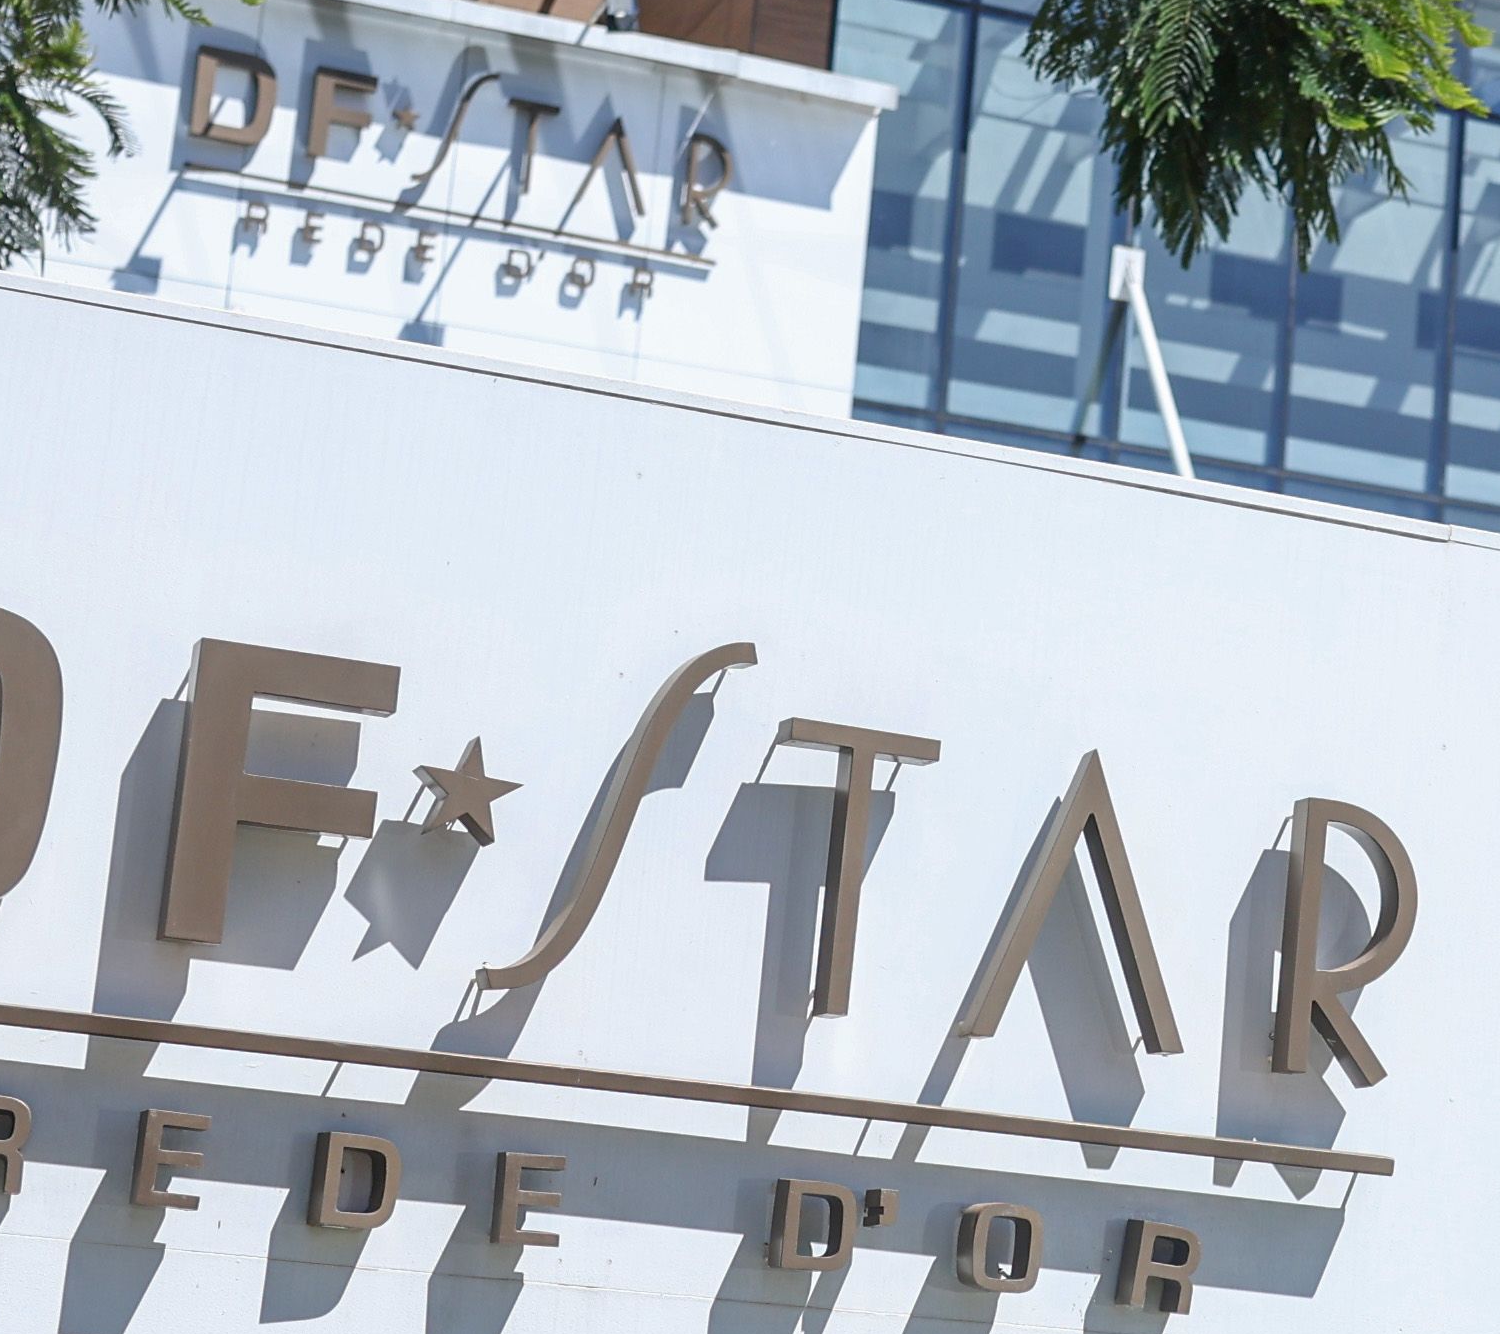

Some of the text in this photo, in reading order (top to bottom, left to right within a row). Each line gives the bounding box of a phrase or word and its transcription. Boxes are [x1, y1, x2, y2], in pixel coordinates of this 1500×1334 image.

[243, 202, 654, 300] REDE D'OR
[767, 1177, 1202, 1316] D'OR
